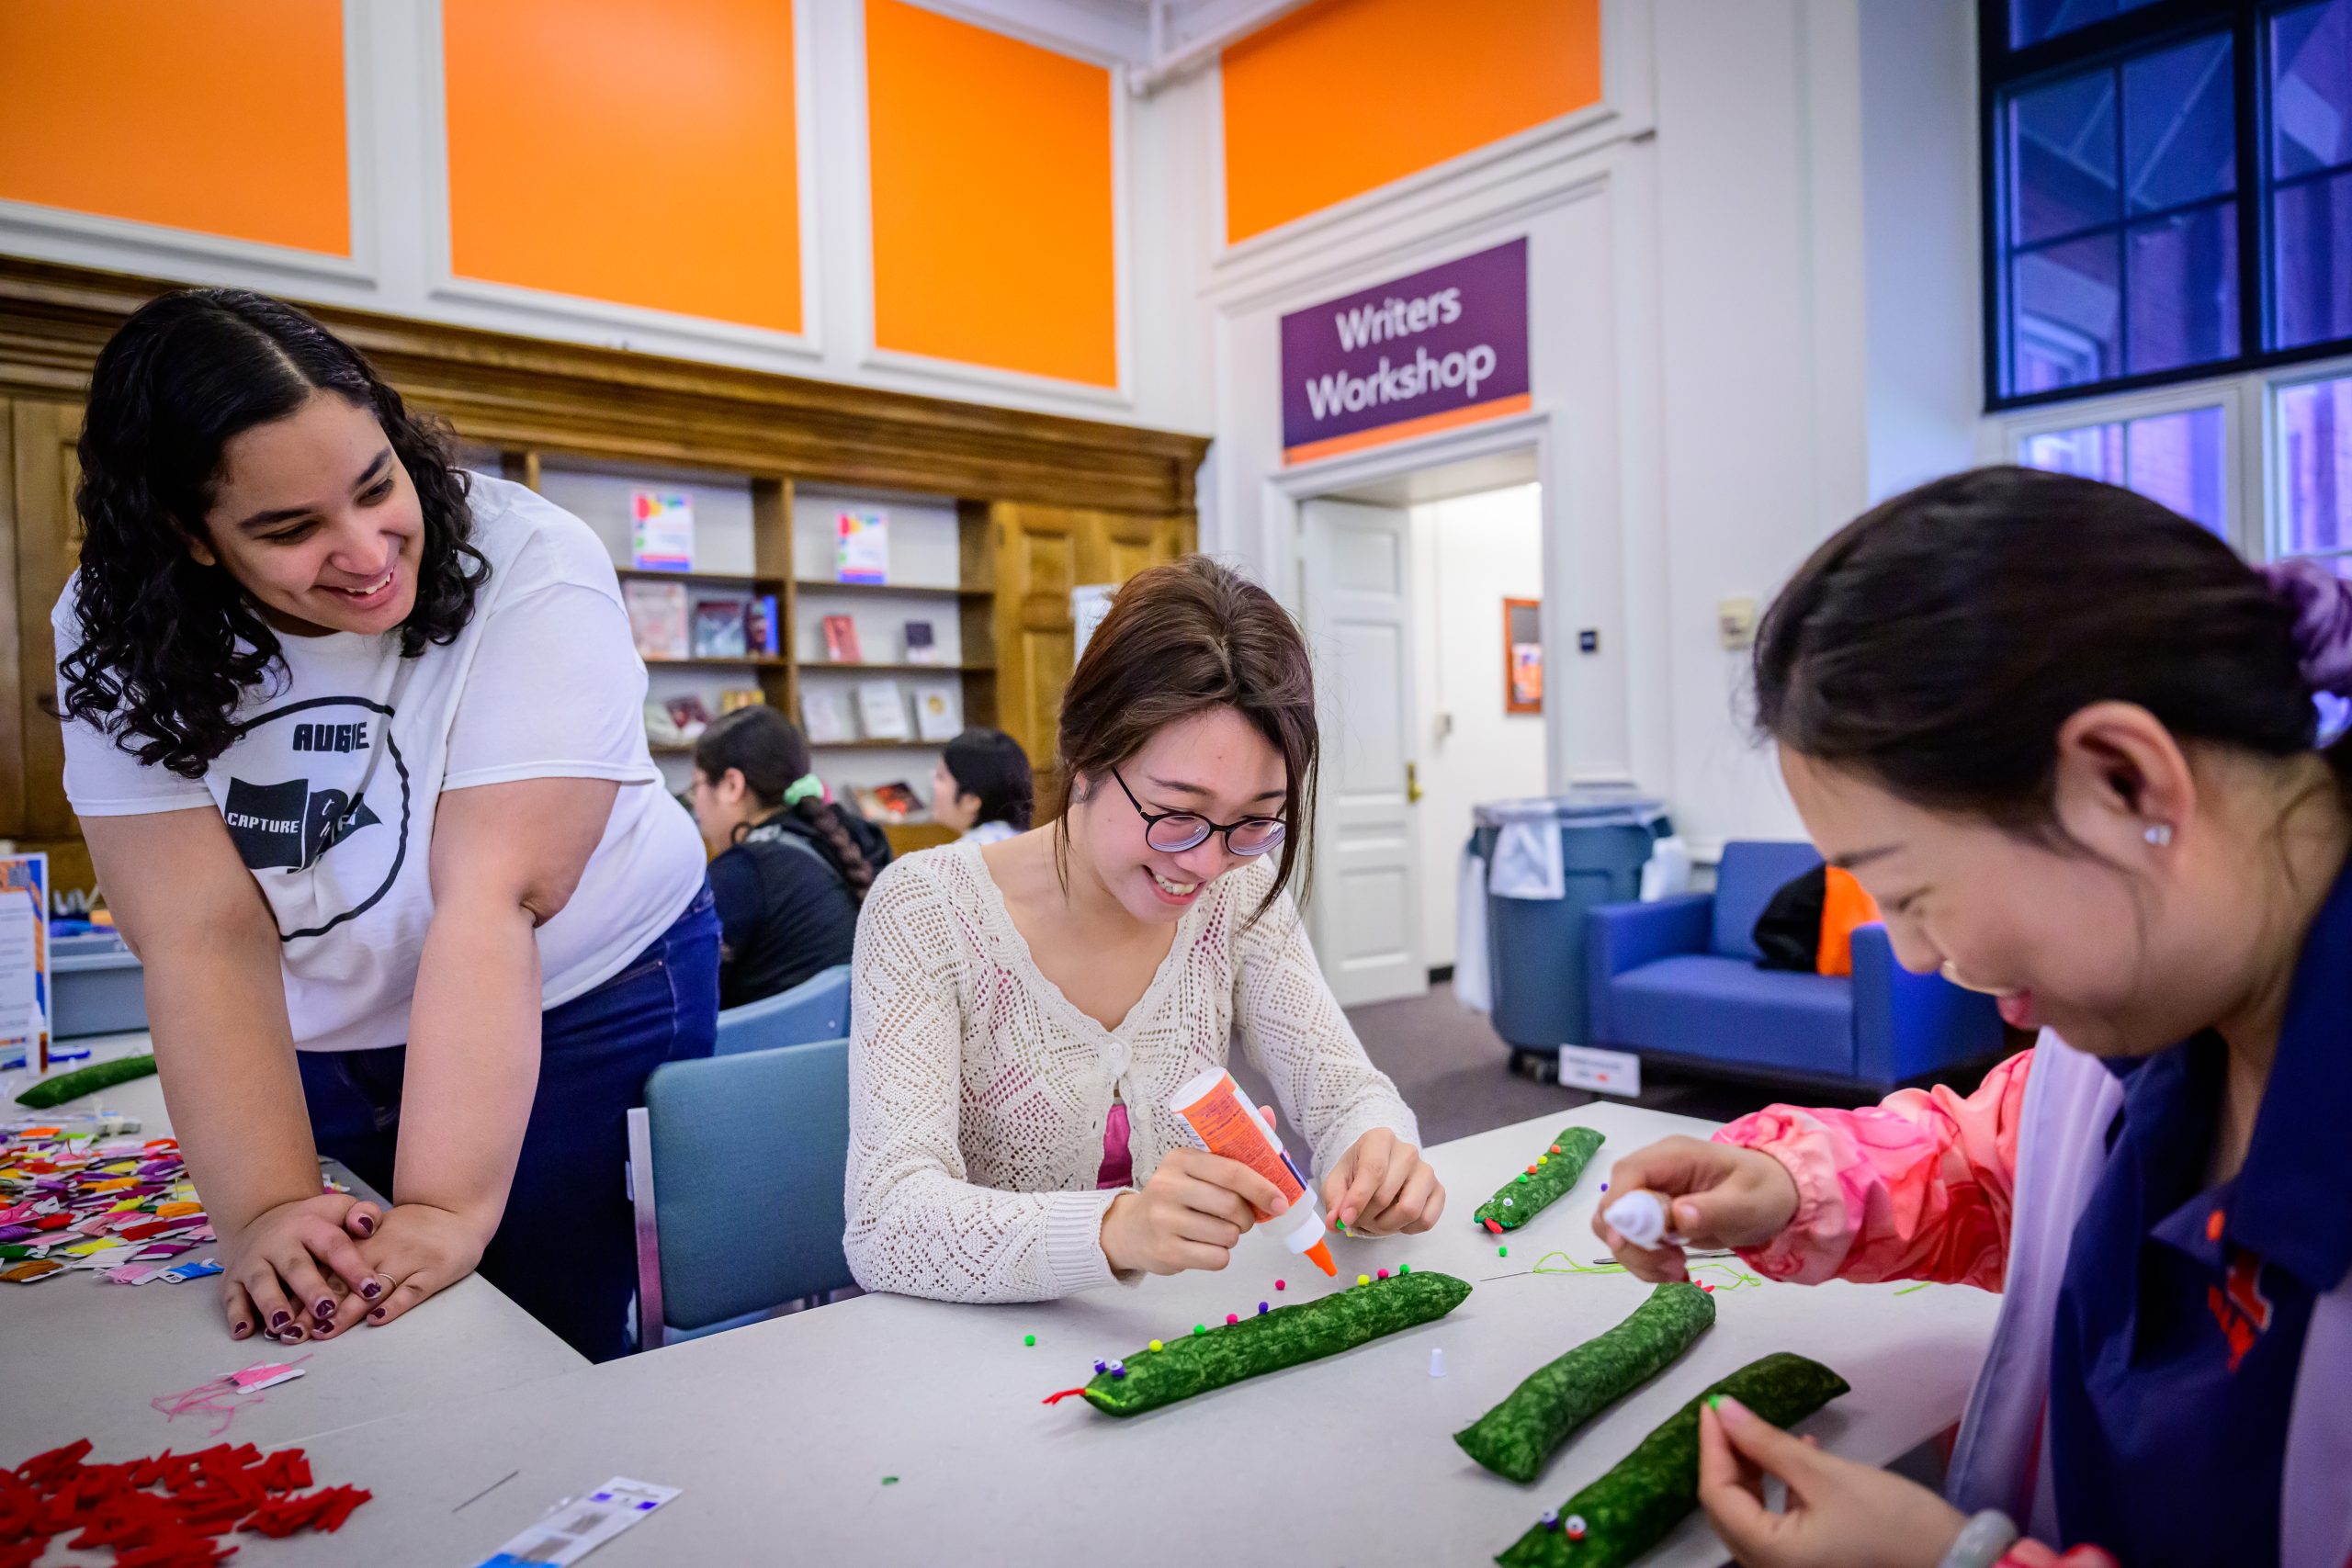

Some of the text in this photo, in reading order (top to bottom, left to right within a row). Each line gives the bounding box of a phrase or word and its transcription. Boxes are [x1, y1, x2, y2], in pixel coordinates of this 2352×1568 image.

[1335, 287, 1462, 353] Writers
[1306, 344, 1497, 421] Workshop
[292, 722, 369, 753] AUGIE
[227, 812, 300, 834] CAPTURE
